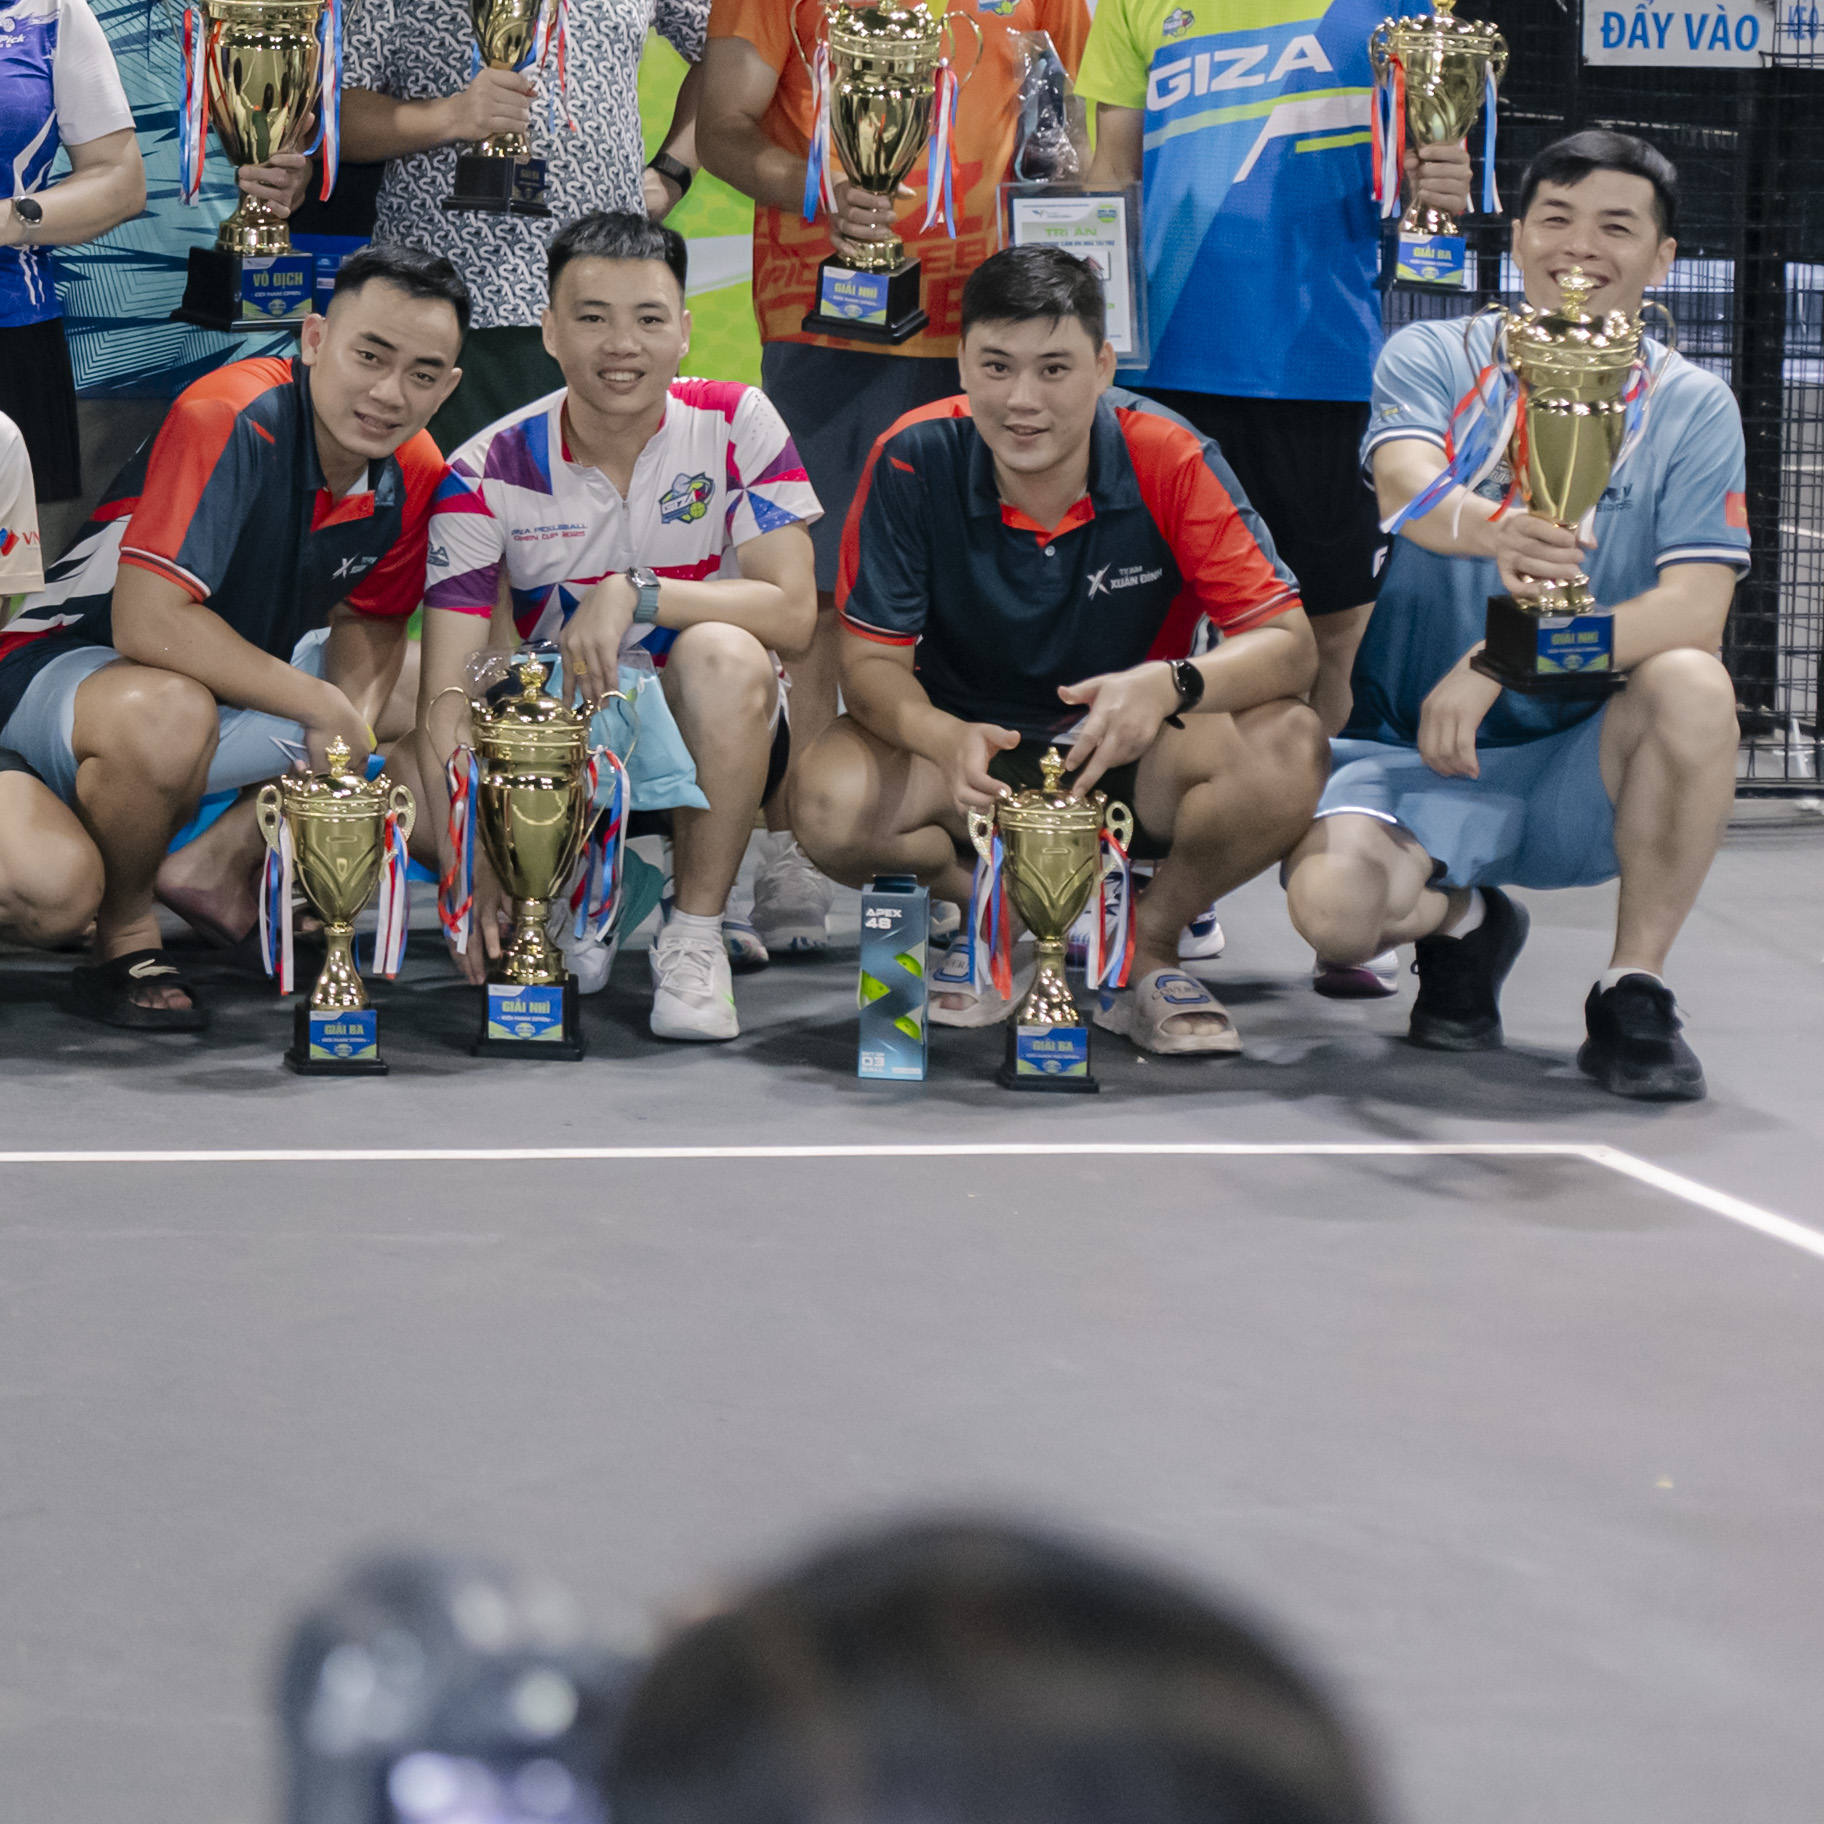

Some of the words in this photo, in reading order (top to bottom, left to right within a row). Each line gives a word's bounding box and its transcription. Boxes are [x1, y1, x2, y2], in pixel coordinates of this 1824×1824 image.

[1682, 4, 1760, 52] VÀO
[1147, 33, 1334, 111] GIZA
[1044, 227, 1070, 237] TRI
[252, 272, 270, 288] VÔ
[273, 271, 304, 289] ĐỊCH
[865, 908, 903, 918] APEX
[501, 999, 526, 1013] GIẢI
[324, 1021, 347, 1035] GIẢI
[348, 1023, 365, 1035] BA
[862, 1057, 885, 1067] 03
